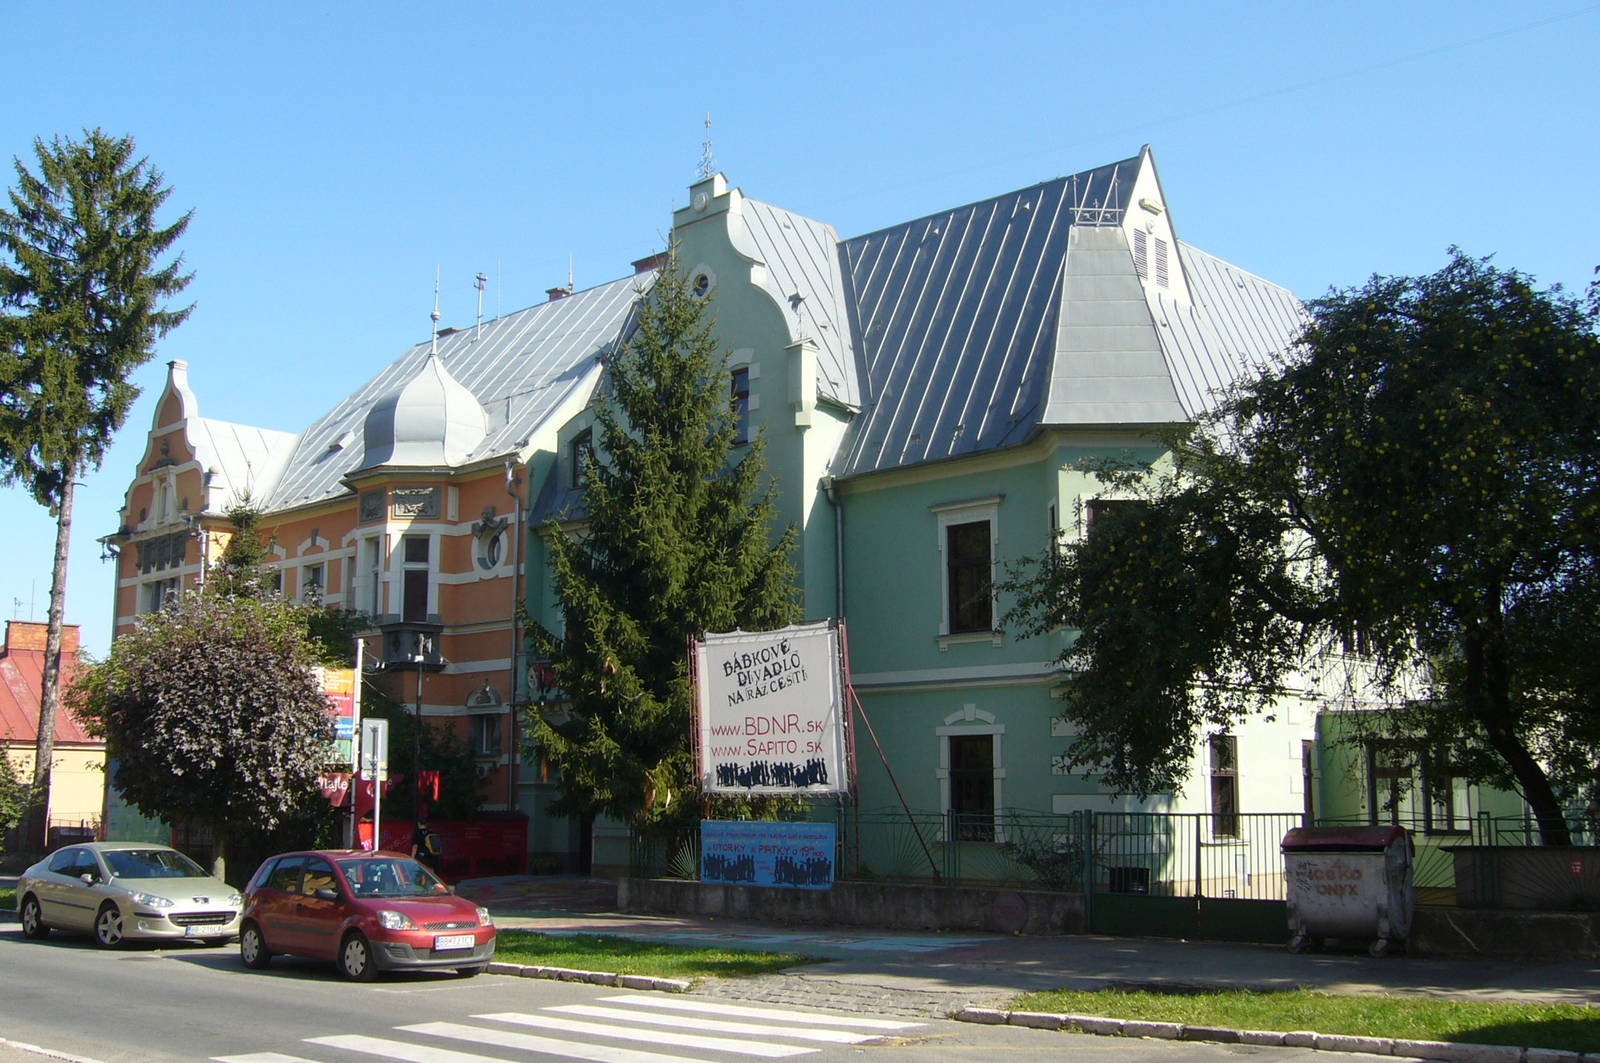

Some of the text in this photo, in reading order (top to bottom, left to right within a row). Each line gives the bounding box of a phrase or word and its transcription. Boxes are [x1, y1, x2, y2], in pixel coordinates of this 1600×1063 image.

[723, 637, 791, 677] BÁBKOVÉ
[737, 653, 801, 687] DIVADLO
[728, 690, 744, 707] NA
